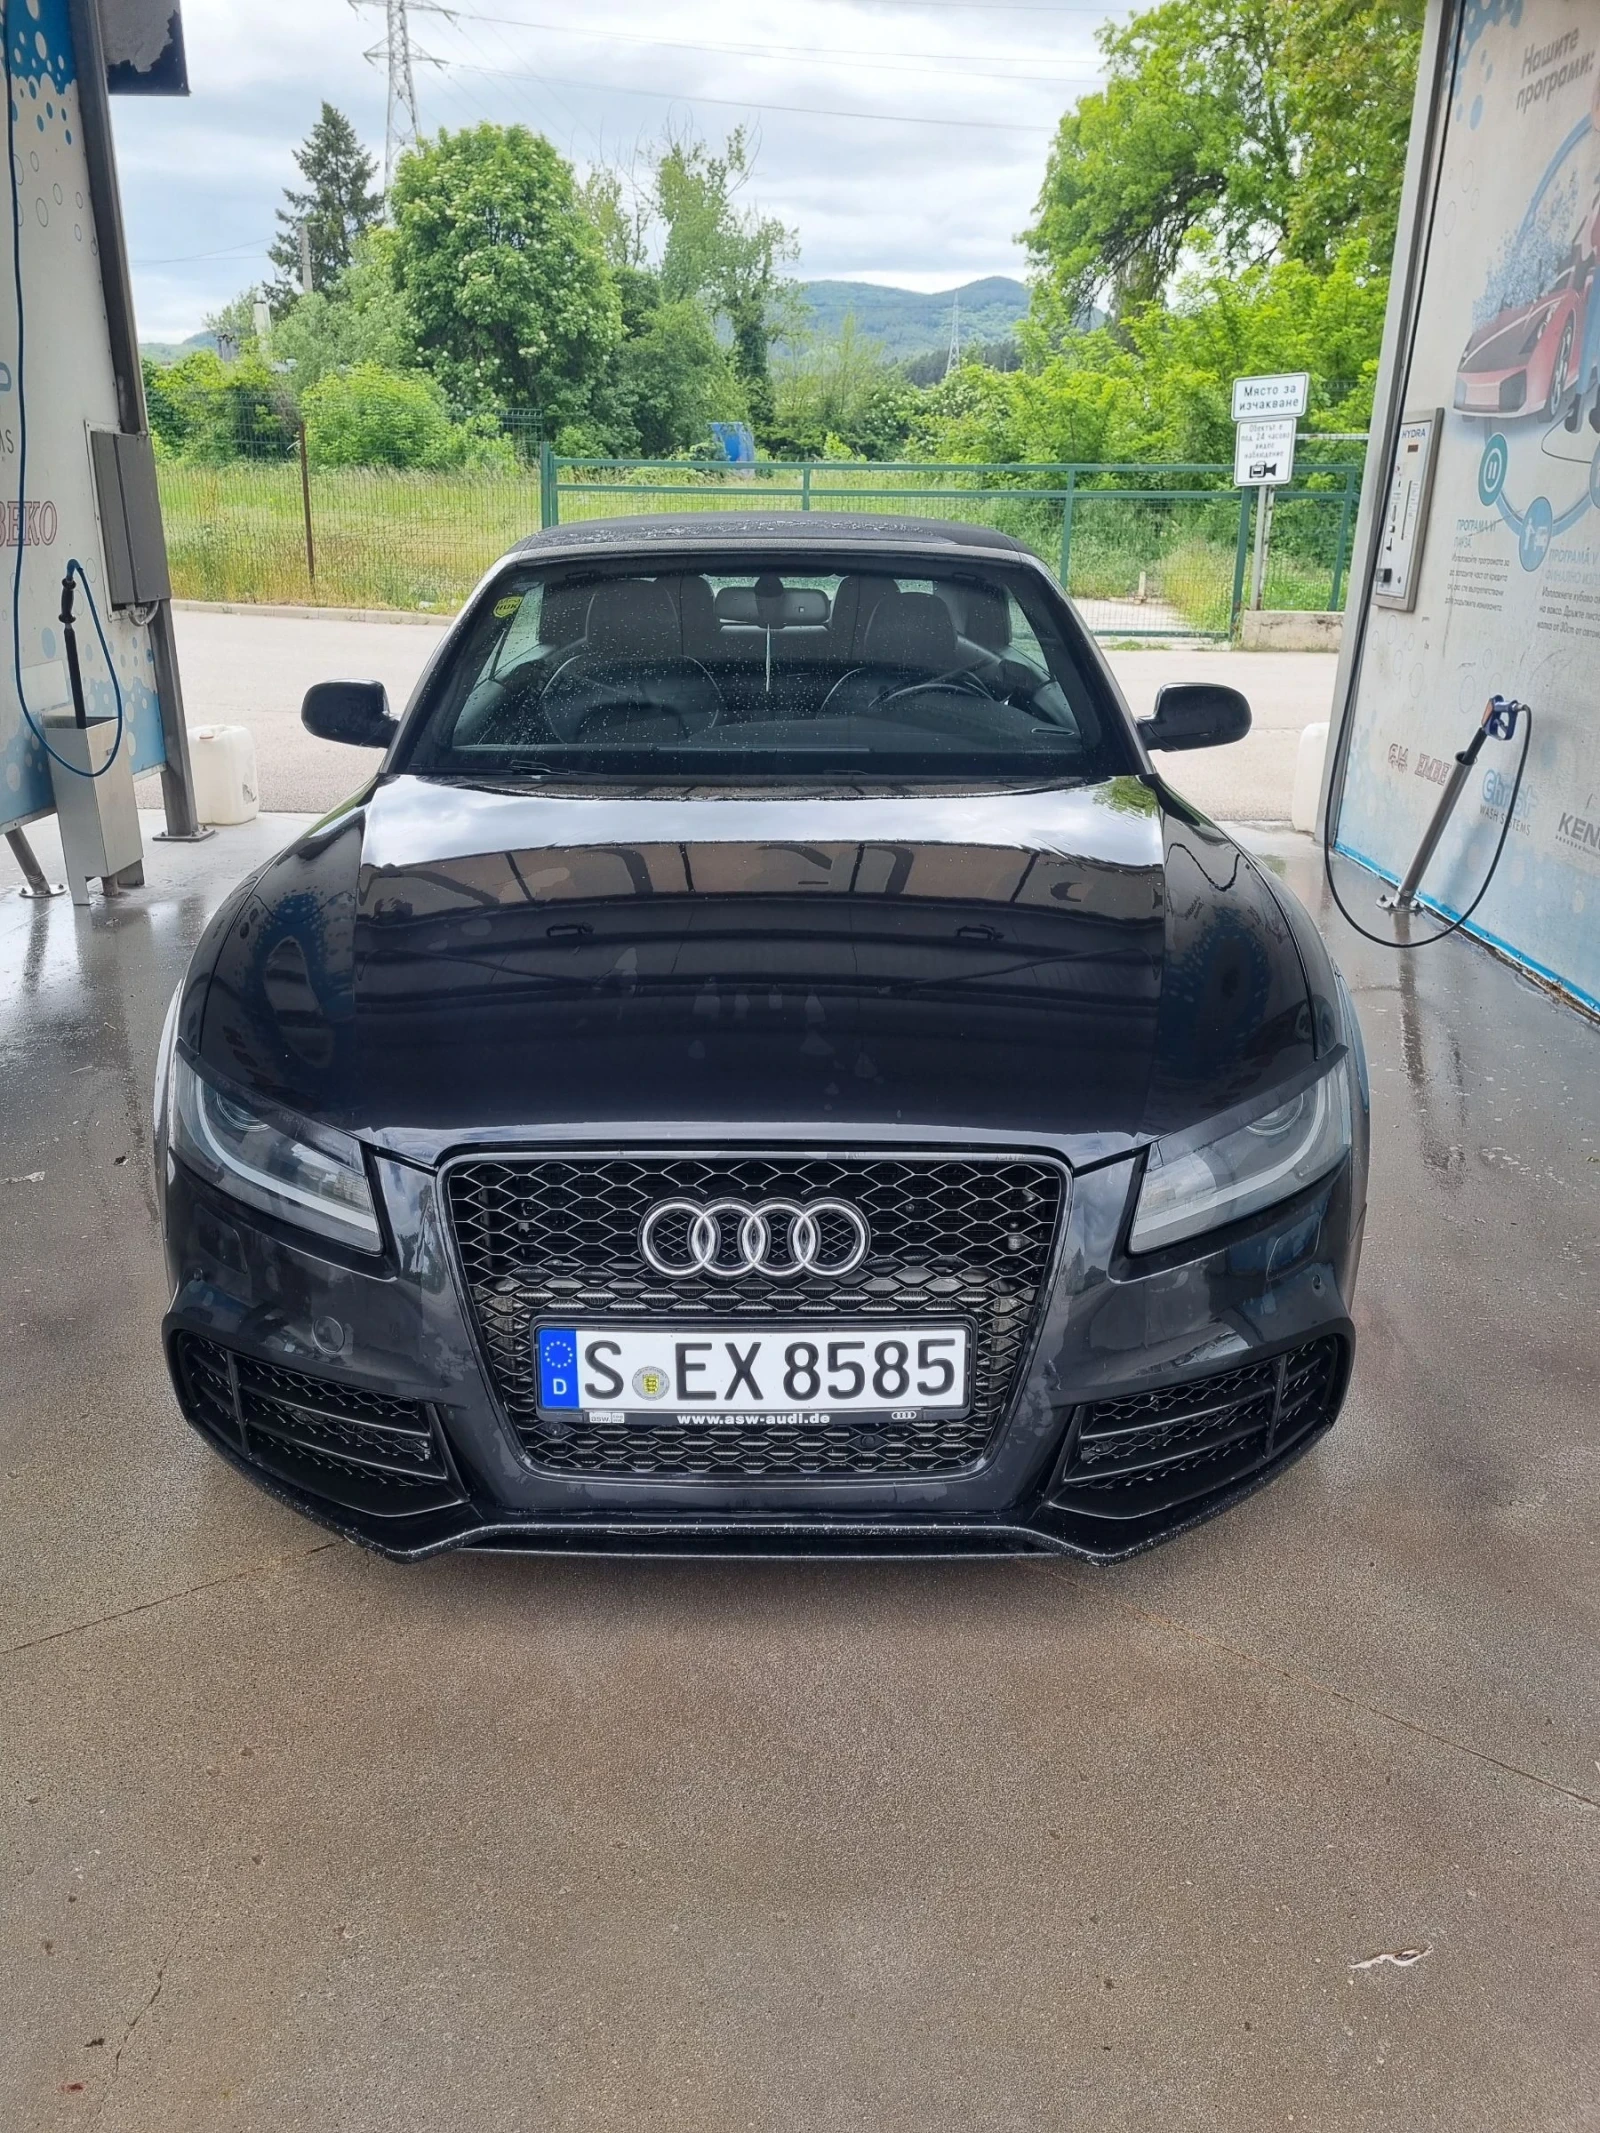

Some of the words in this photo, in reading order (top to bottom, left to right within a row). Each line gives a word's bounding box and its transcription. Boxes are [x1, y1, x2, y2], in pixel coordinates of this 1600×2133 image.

[1521, 27, 1579, 79] Нашите
[1244, 386, 1279, 397] Място
[1283, 385, 1297, 394] за
[1239, 398, 1299, 411] изчакване
[1402, 428, 1426, 439] HYDRA
[1480, 804, 1499, 822] WASH
[1499, 812, 1532, 837] SSTEMS
[1558, 812, 1600, 851] KEN
[584, 1340, 624, 1400] S
[675, 1342, 764, 1401] EX
[783, 1338, 956, 1401] 8585
[553, 1379, 567, 1395] D
[677, 1412, 830, 1425] www.asw-audi.de
